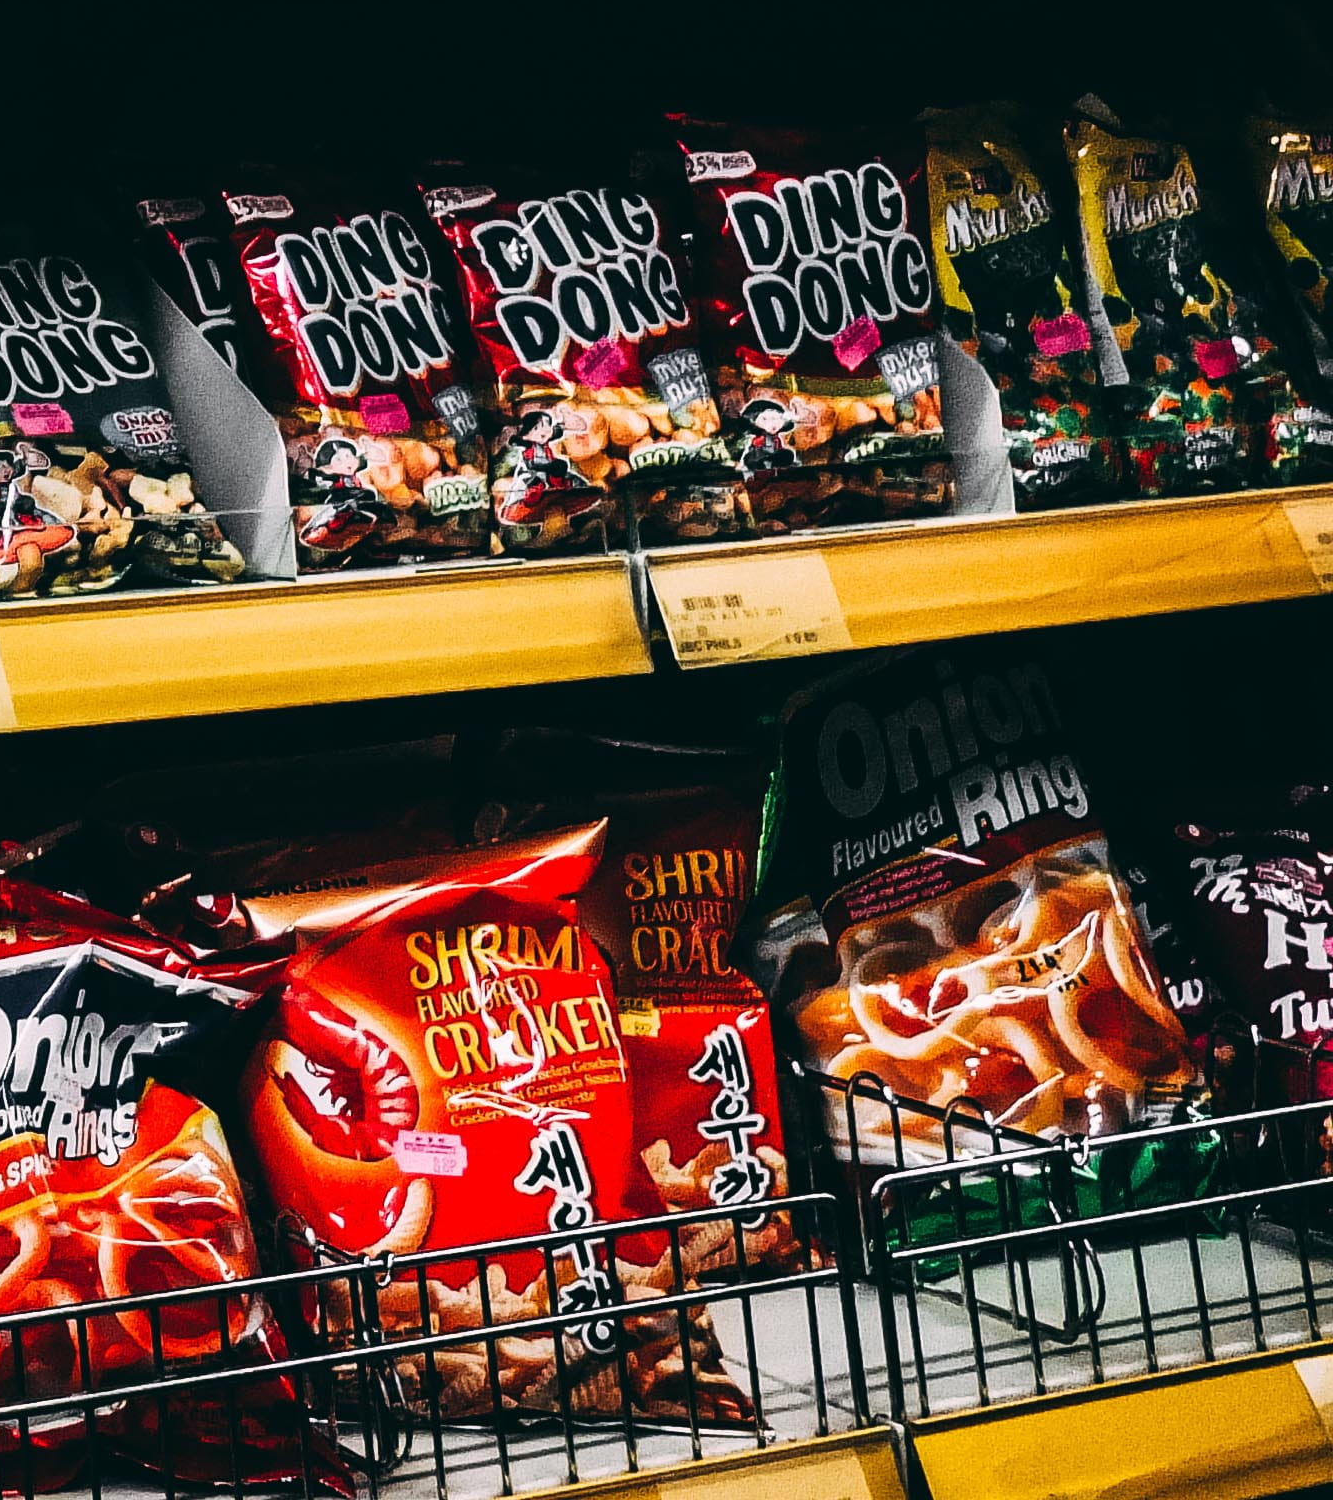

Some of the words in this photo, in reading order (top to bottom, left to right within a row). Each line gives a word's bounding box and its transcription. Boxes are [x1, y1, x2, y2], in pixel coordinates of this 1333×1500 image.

[274, 209, 432, 313] DING
[469, 188, 660, 296] DING
[725, 162, 907, 274] DING
[494, 250, 690, 371] DONG
[741, 234, 932, 358] DONG
[815, 656, 1063, 820] Onion
[831, 793, 944, 878] Flavoured
[947, 753, 1091, 851] Ring
[46, 1094, 138, 1168] Rings
